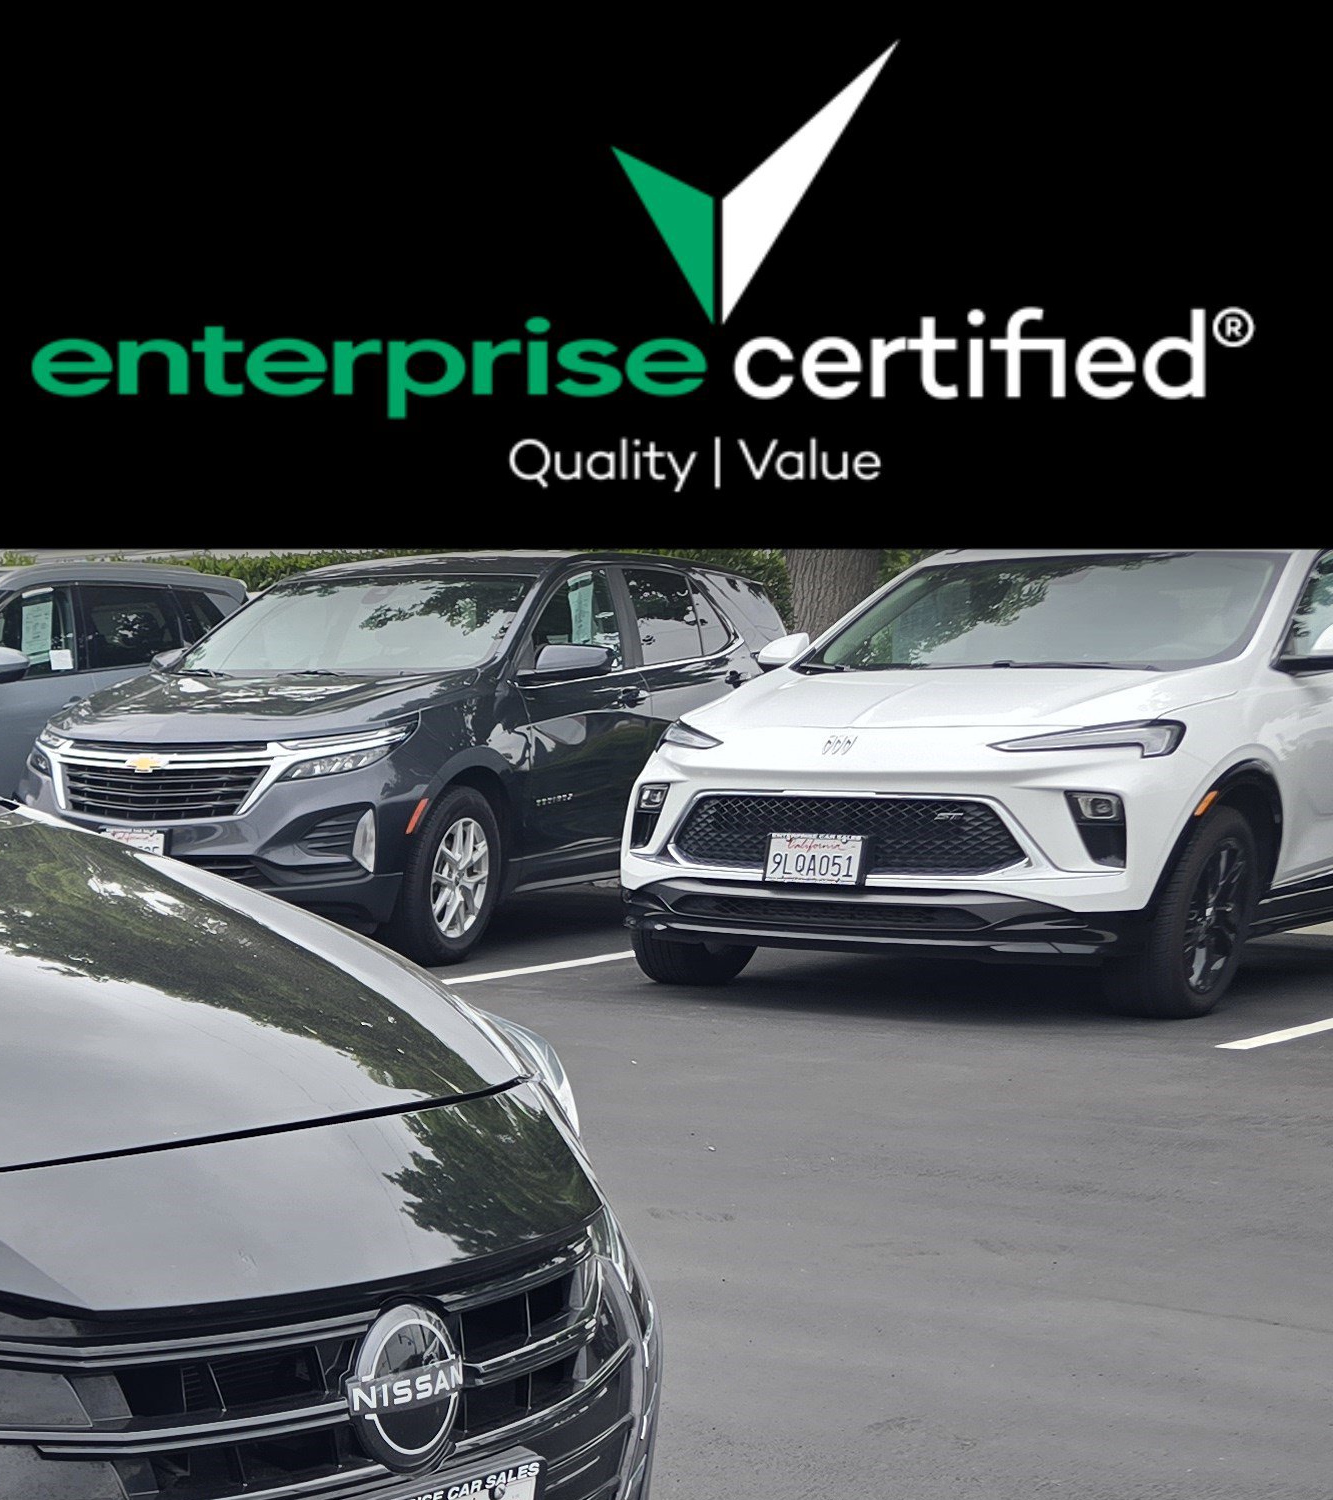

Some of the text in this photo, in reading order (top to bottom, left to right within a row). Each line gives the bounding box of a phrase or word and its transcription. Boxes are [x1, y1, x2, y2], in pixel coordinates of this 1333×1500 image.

[770, 853, 853, 878] 9LQA051
[352, 1355, 464, 1411] NISSAN
[447, 1479, 483, 1500] CAR
[485, 1462, 540, 1488] SALES
